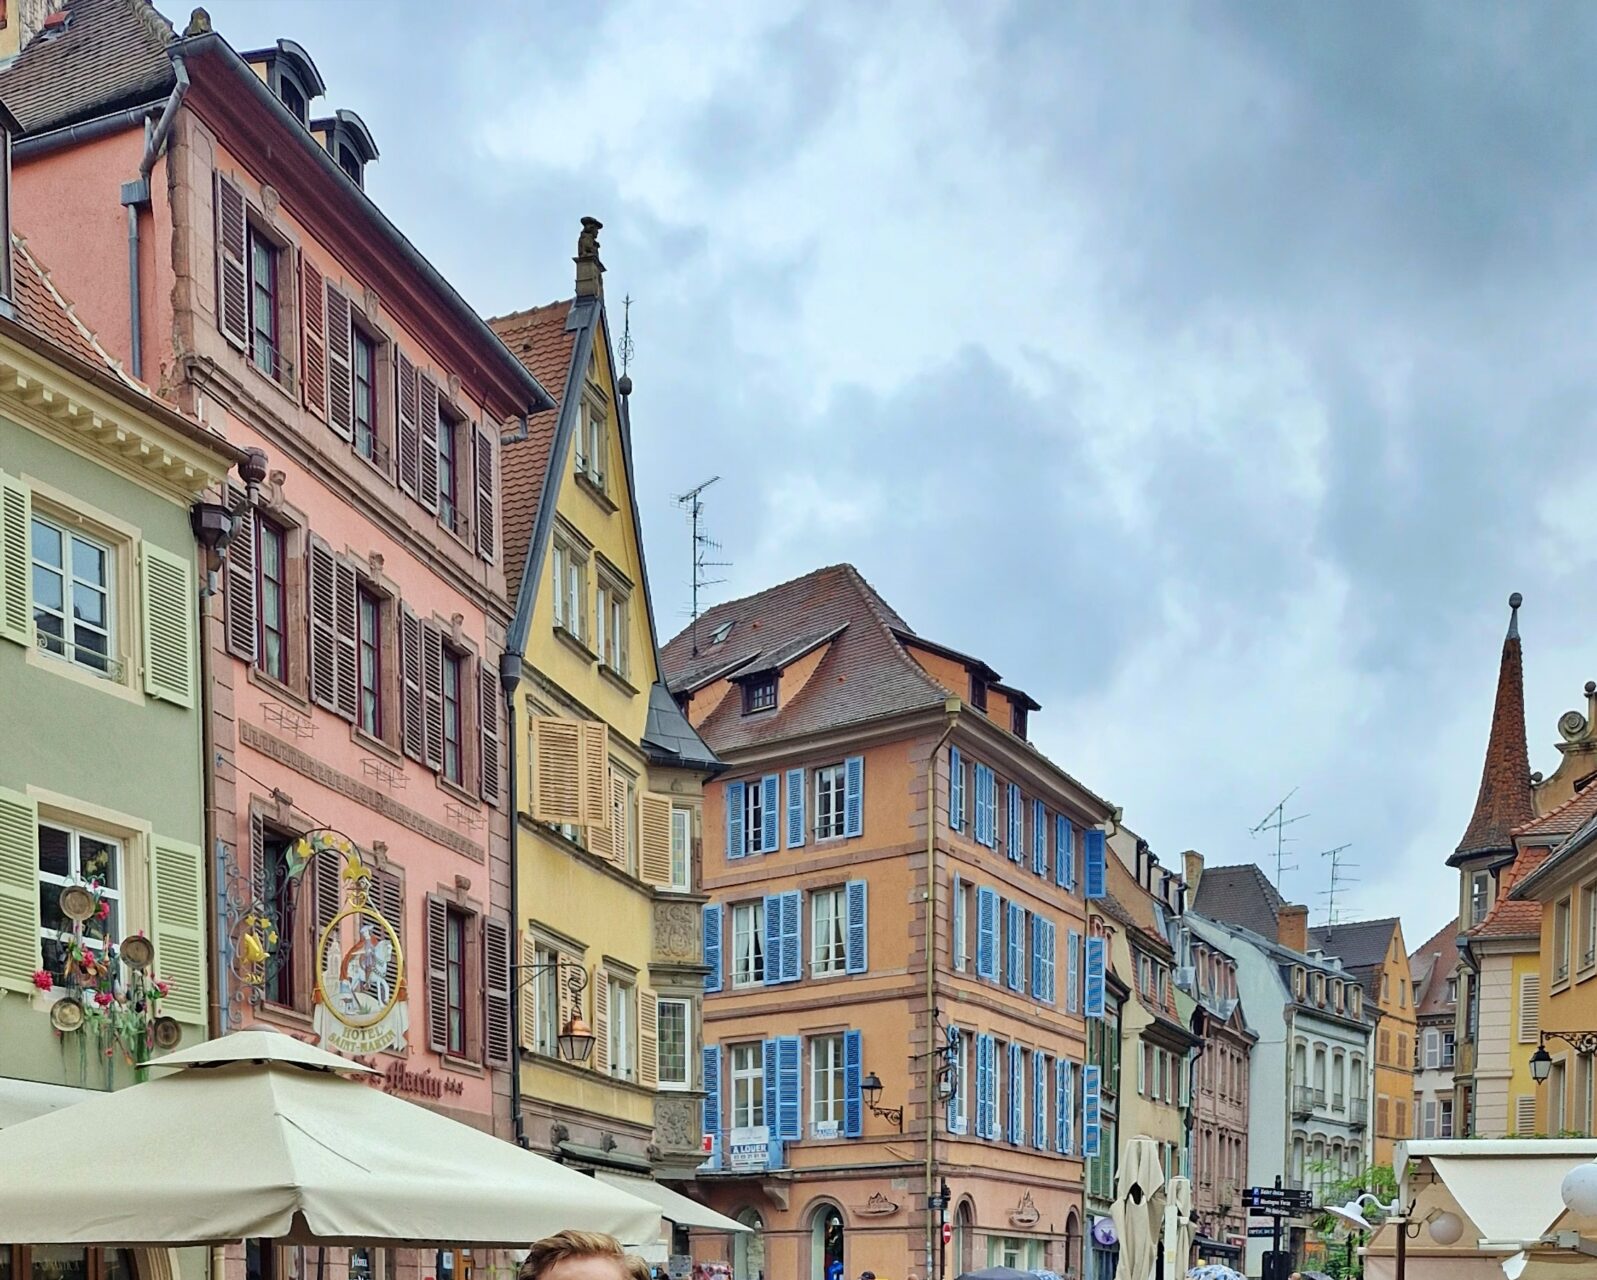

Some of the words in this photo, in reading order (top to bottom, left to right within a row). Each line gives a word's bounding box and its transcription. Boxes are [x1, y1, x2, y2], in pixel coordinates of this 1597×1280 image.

[328, 1030, 397, 1051] SAINT-MARTIN
[342, 1026, 384, 1041] HOTEL
[741, 1144, 767, 1153] LOUER
